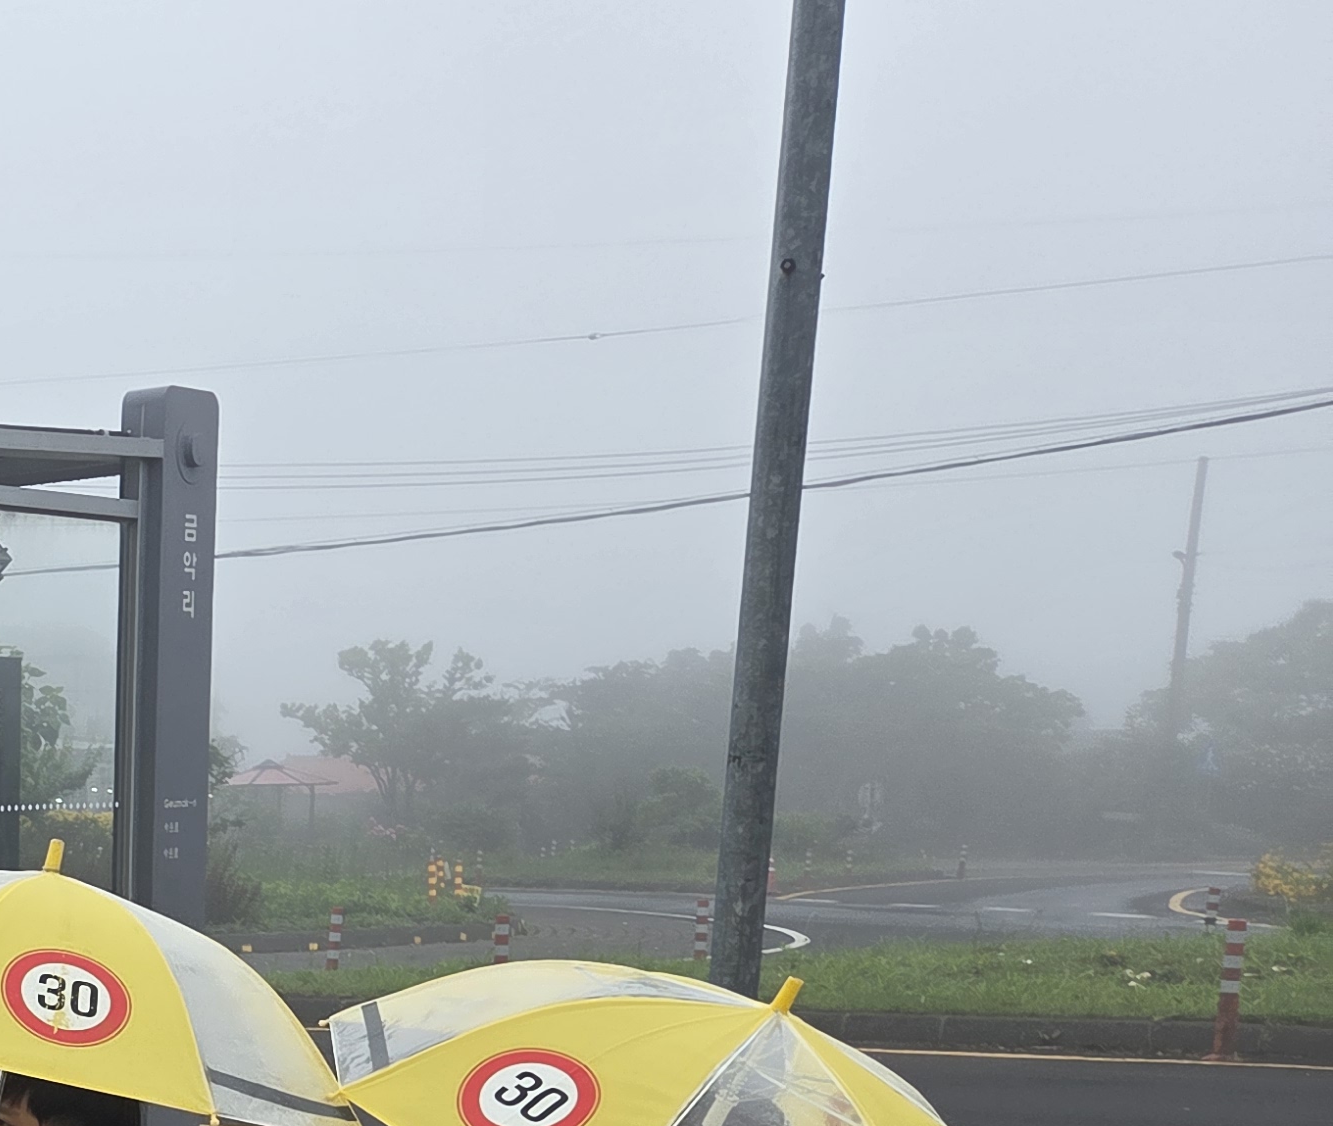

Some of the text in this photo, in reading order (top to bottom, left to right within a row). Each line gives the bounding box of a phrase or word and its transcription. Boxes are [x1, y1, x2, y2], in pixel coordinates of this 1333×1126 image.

[182, 513, 197, 619] 금악리
[37, 973, 99, 1018] 30
[494, 1071, 569, 1122] 30
